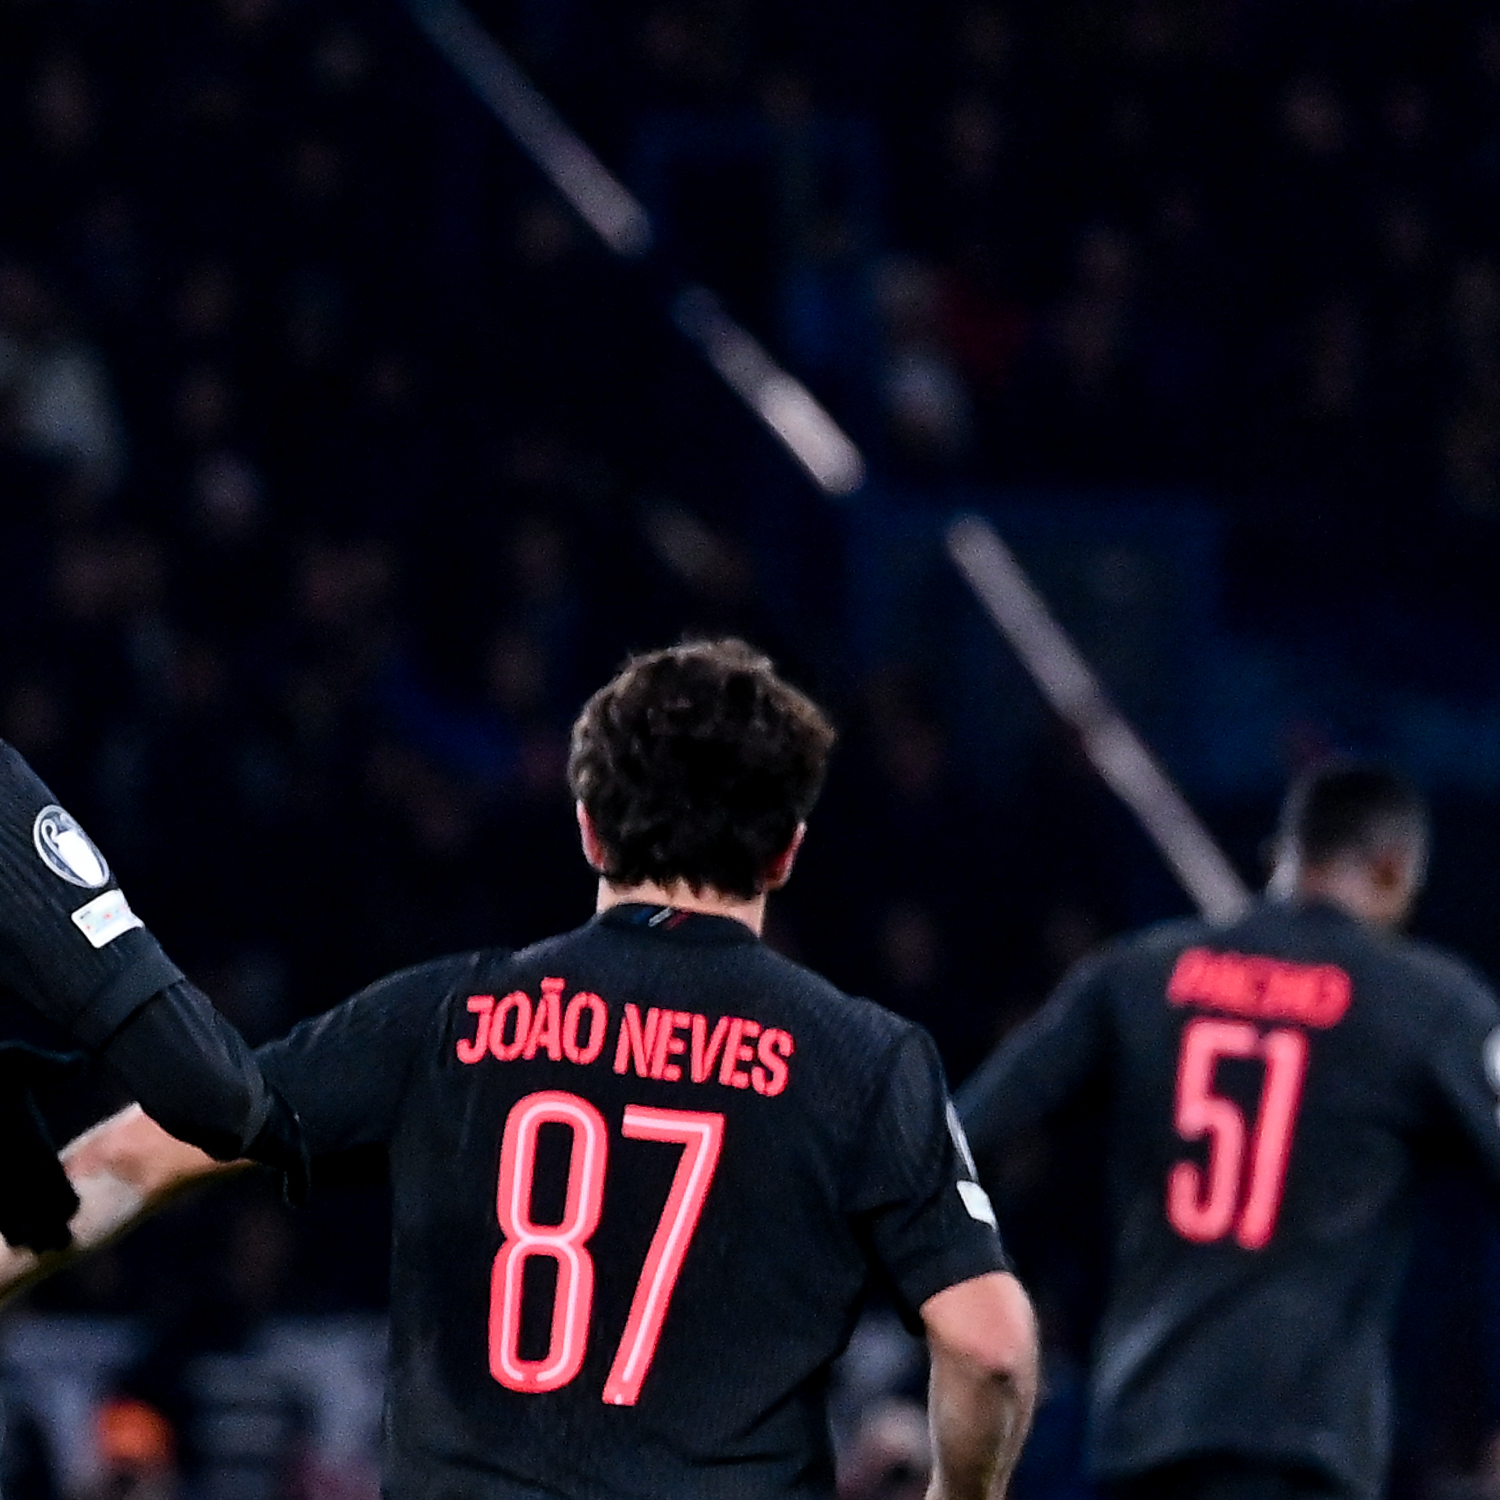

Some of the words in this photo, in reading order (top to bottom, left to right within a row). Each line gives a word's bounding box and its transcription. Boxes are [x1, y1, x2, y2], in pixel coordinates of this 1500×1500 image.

[456, 976, 608, 1065] JOÃO
[613, 1003, 795, 1097] NEVES
[1167, 1017, 1308, 1250] 51
[488, 1090, 726, 1406] 87
